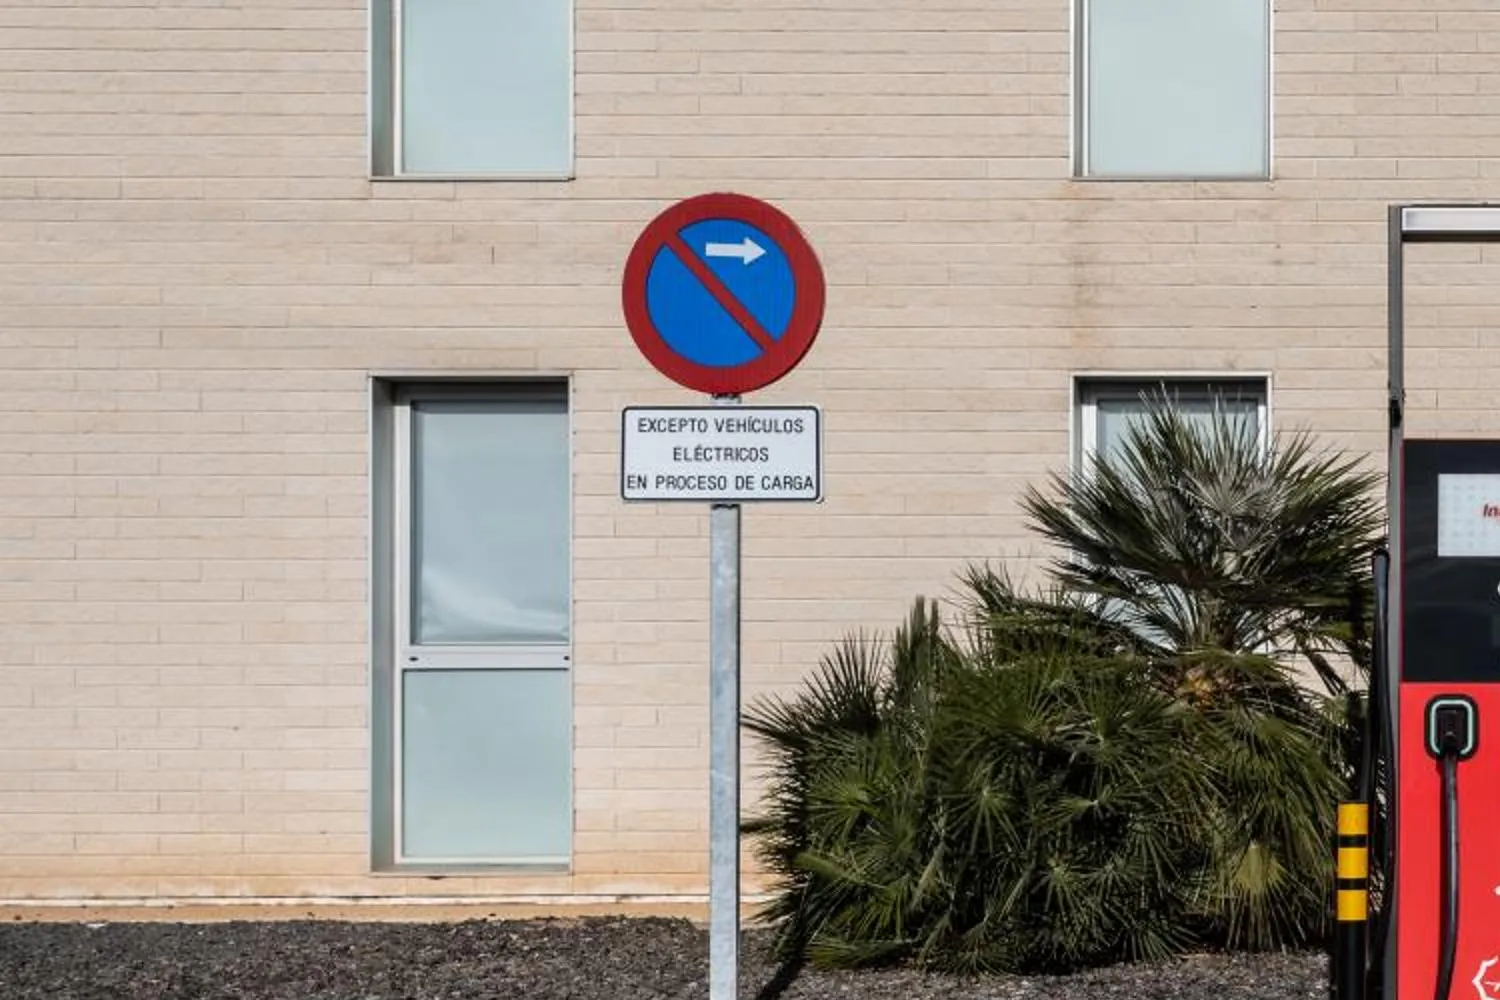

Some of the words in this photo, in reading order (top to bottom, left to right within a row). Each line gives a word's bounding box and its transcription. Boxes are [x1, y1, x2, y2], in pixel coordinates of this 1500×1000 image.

[637, 417, 708, 433] EXCEPTO
[714, 415, 804, 433] VEHÍCULOS
[672, 445, 769, 462] ELÉCTRICOS
[626, 475, 648, 490] EN
[655, 475, 727, 490] PROCESO
[735, 475, 755, 490] DE
[761, 475, 815, 490] CARGA
